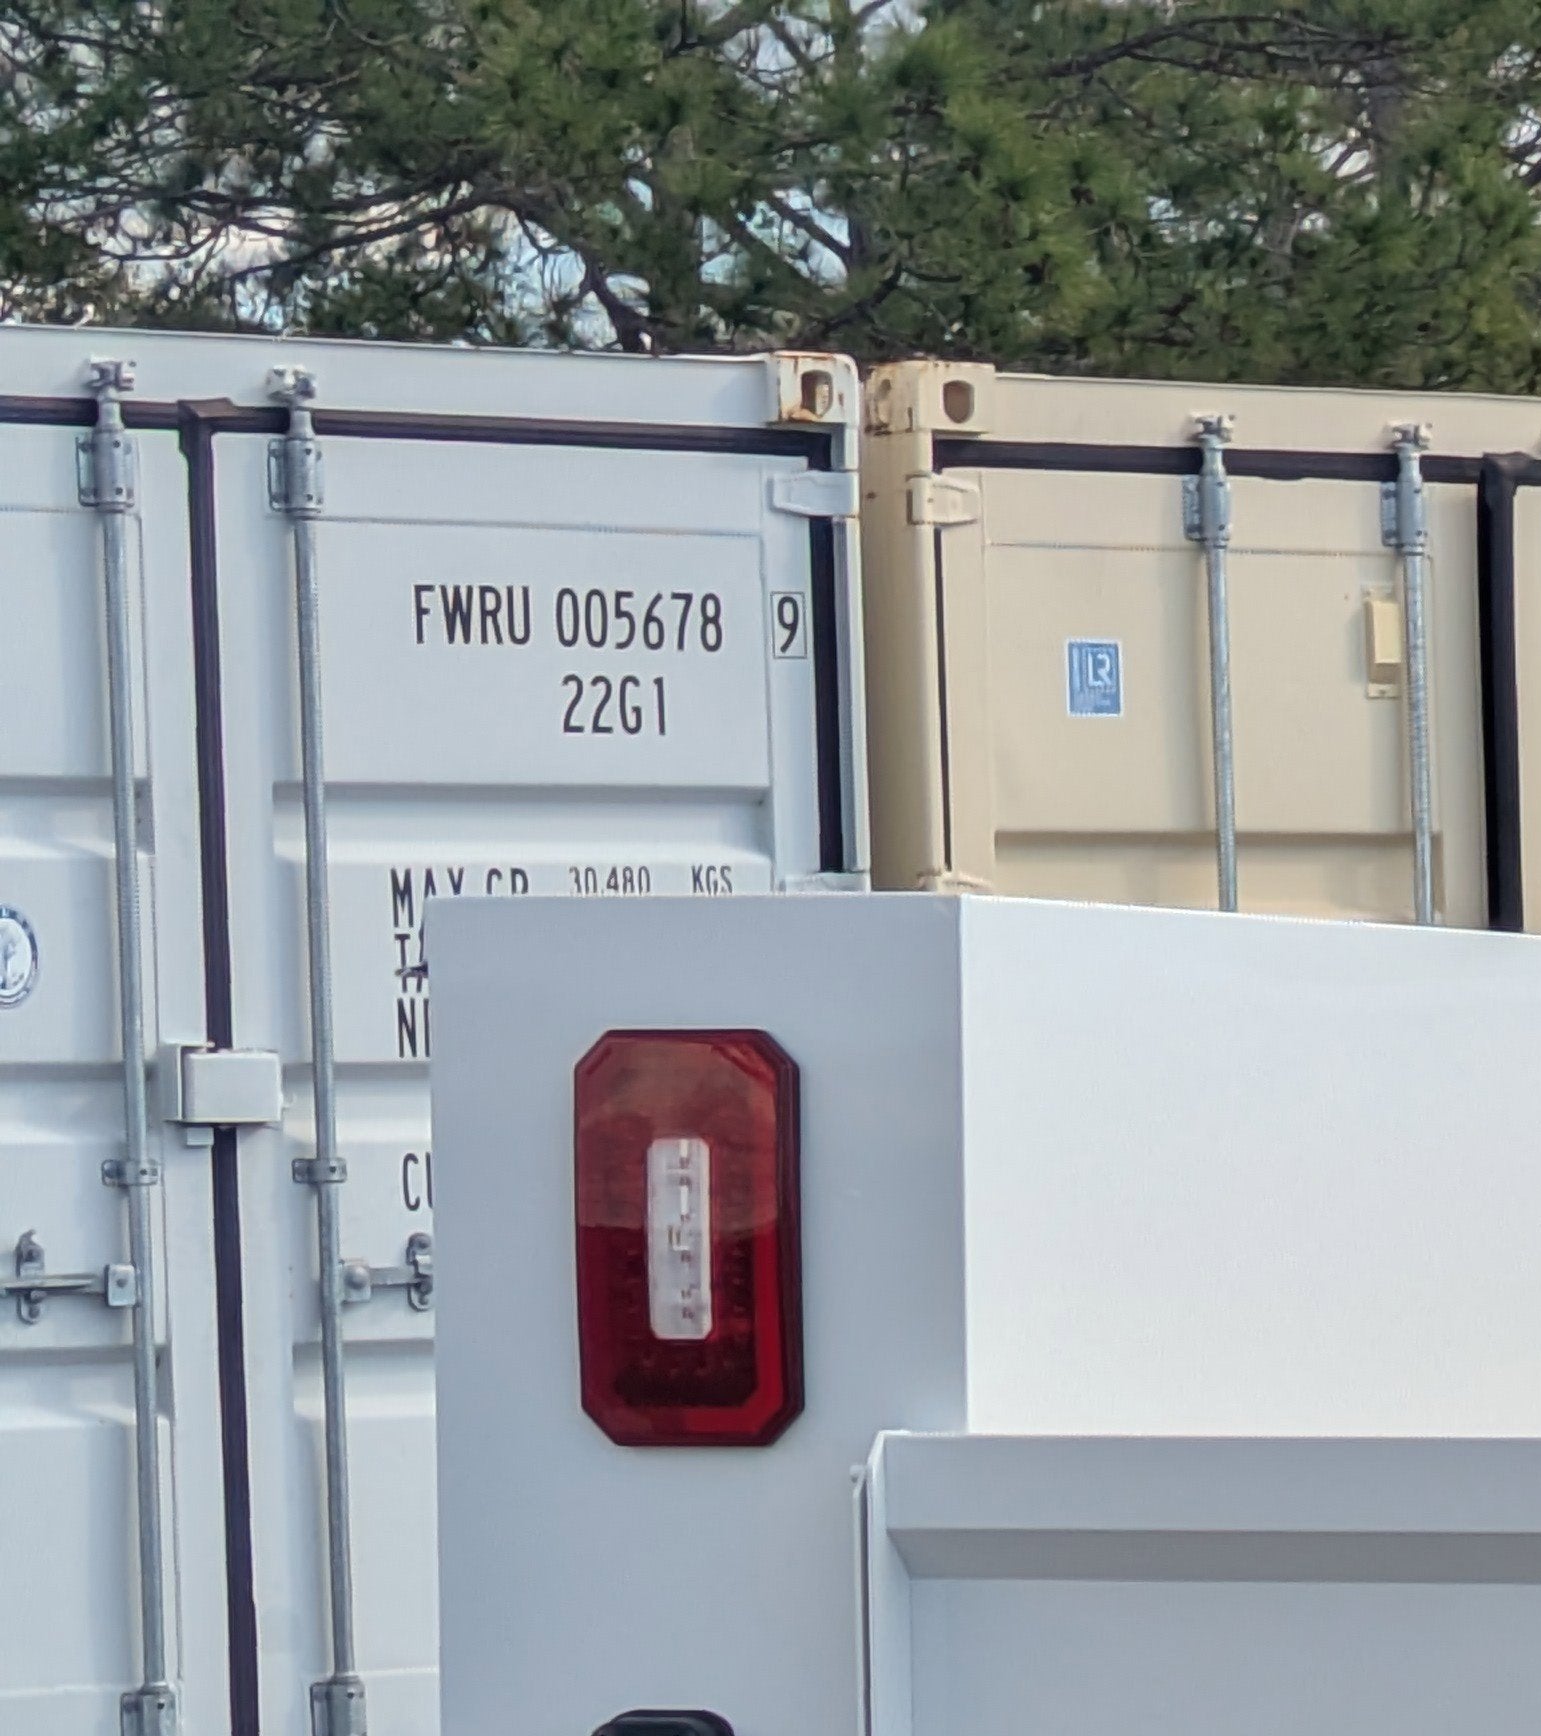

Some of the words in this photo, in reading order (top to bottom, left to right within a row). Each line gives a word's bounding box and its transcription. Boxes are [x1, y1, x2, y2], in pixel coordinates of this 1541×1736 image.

[412, 584, 531, 645] FWRU
[555, 587, 724, 653] 005678
[776, 595, 800, 654] 9
[561, 673, 667, 736] 22G1
[691, 864, 733, 895] KGS
